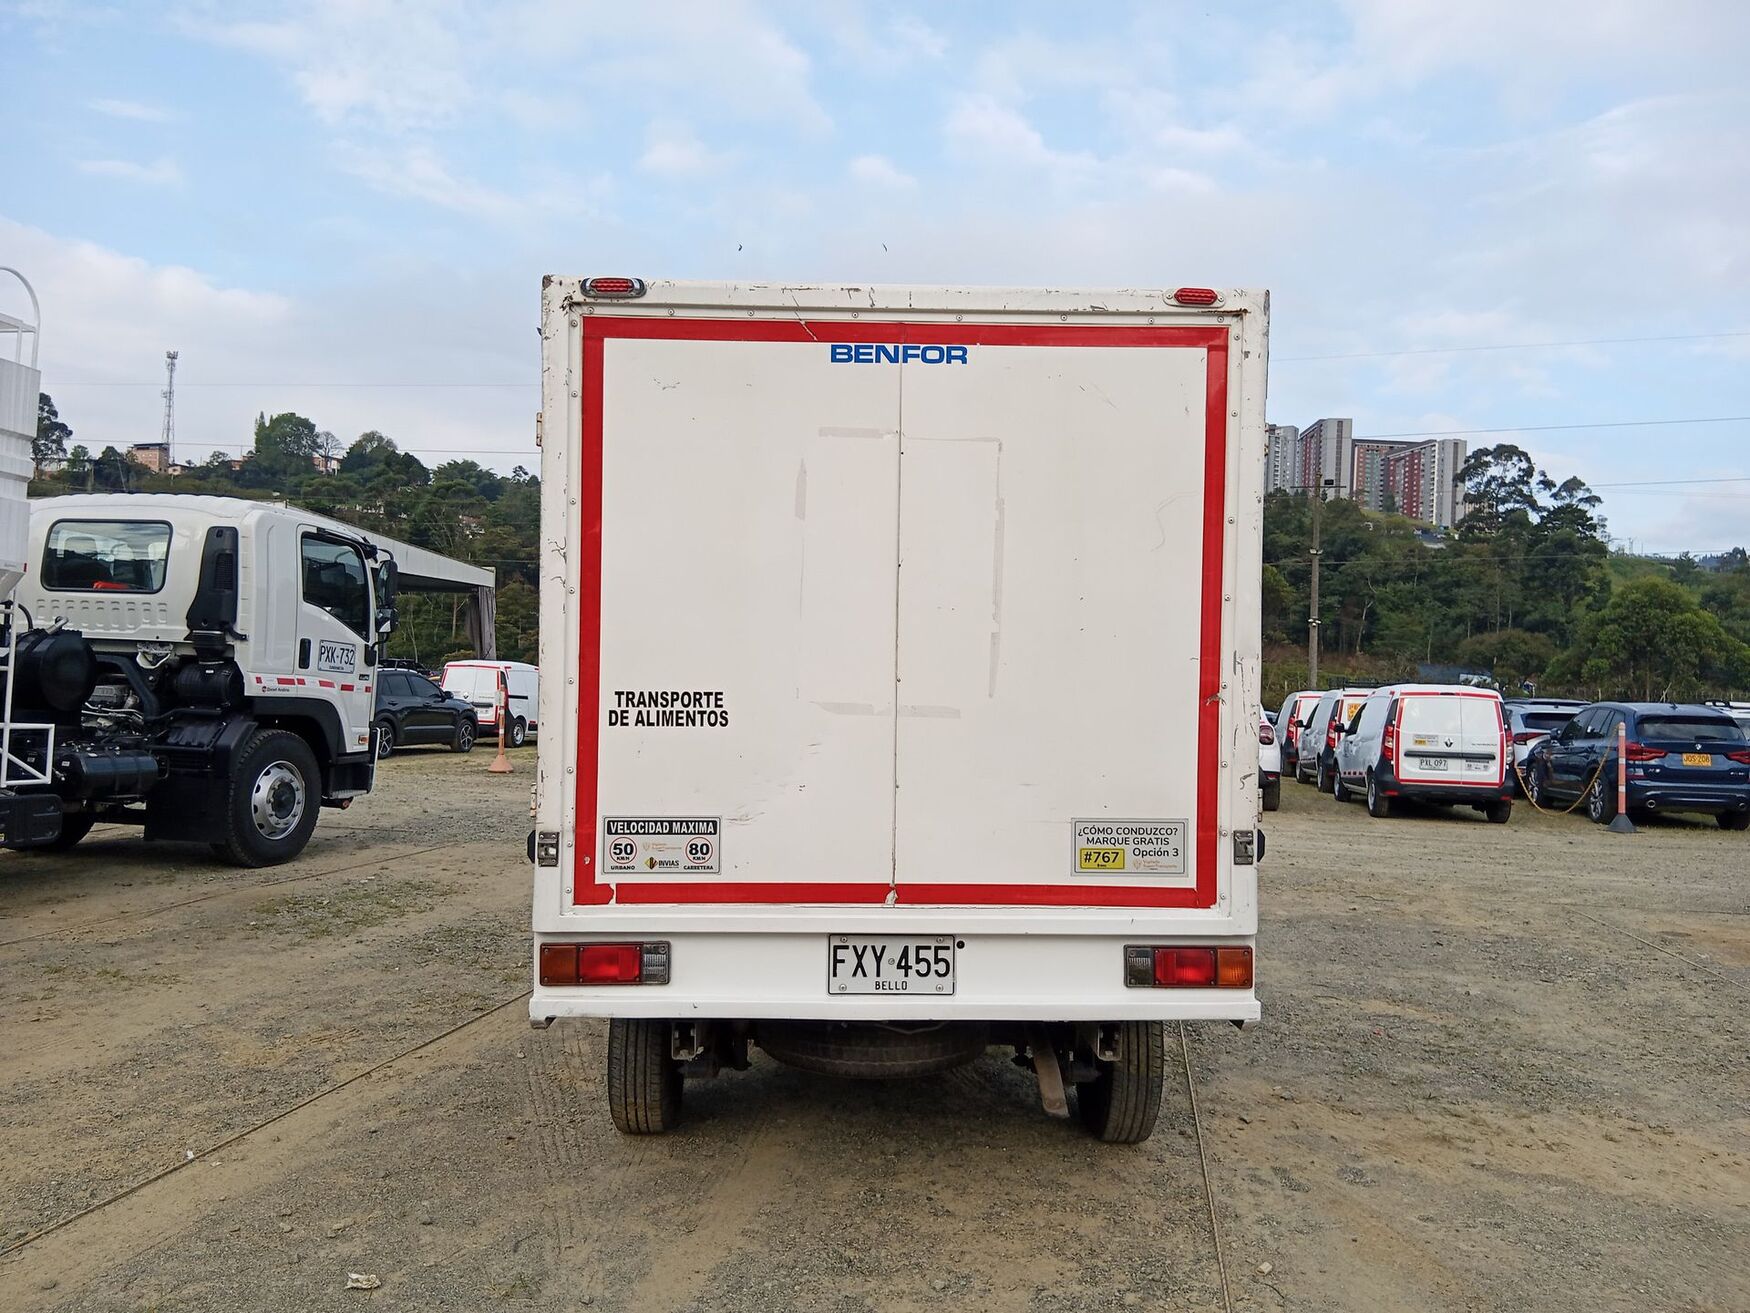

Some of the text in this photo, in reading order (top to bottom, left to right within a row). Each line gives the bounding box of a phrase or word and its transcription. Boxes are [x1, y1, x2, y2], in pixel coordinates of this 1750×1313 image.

[831, 344, 967, 364] BENFOR
[319, 645, 355, 666] PXK-732
[614, 691, 724, 708] TRANSPORTE
[608, 710, 729, 727] DE ALIMENTOS
[610, 822, 715, 833] VELOCIDAD MAXIMA
[1078, 825, 1178, 836] ¿CÓMO CONDUZCO?
[1086, 837, 1170, 847] MARQUE GRATIS
[612, 843, 634, 855] 50
[688, 843, 710, 855] 80
[1132, 847, 1179, 858] Opción 3
[1084, 851, 1120, 863] #767
[832, 945, 951, 978] FXY 455
[874, 980, 908, 990] BELLO
